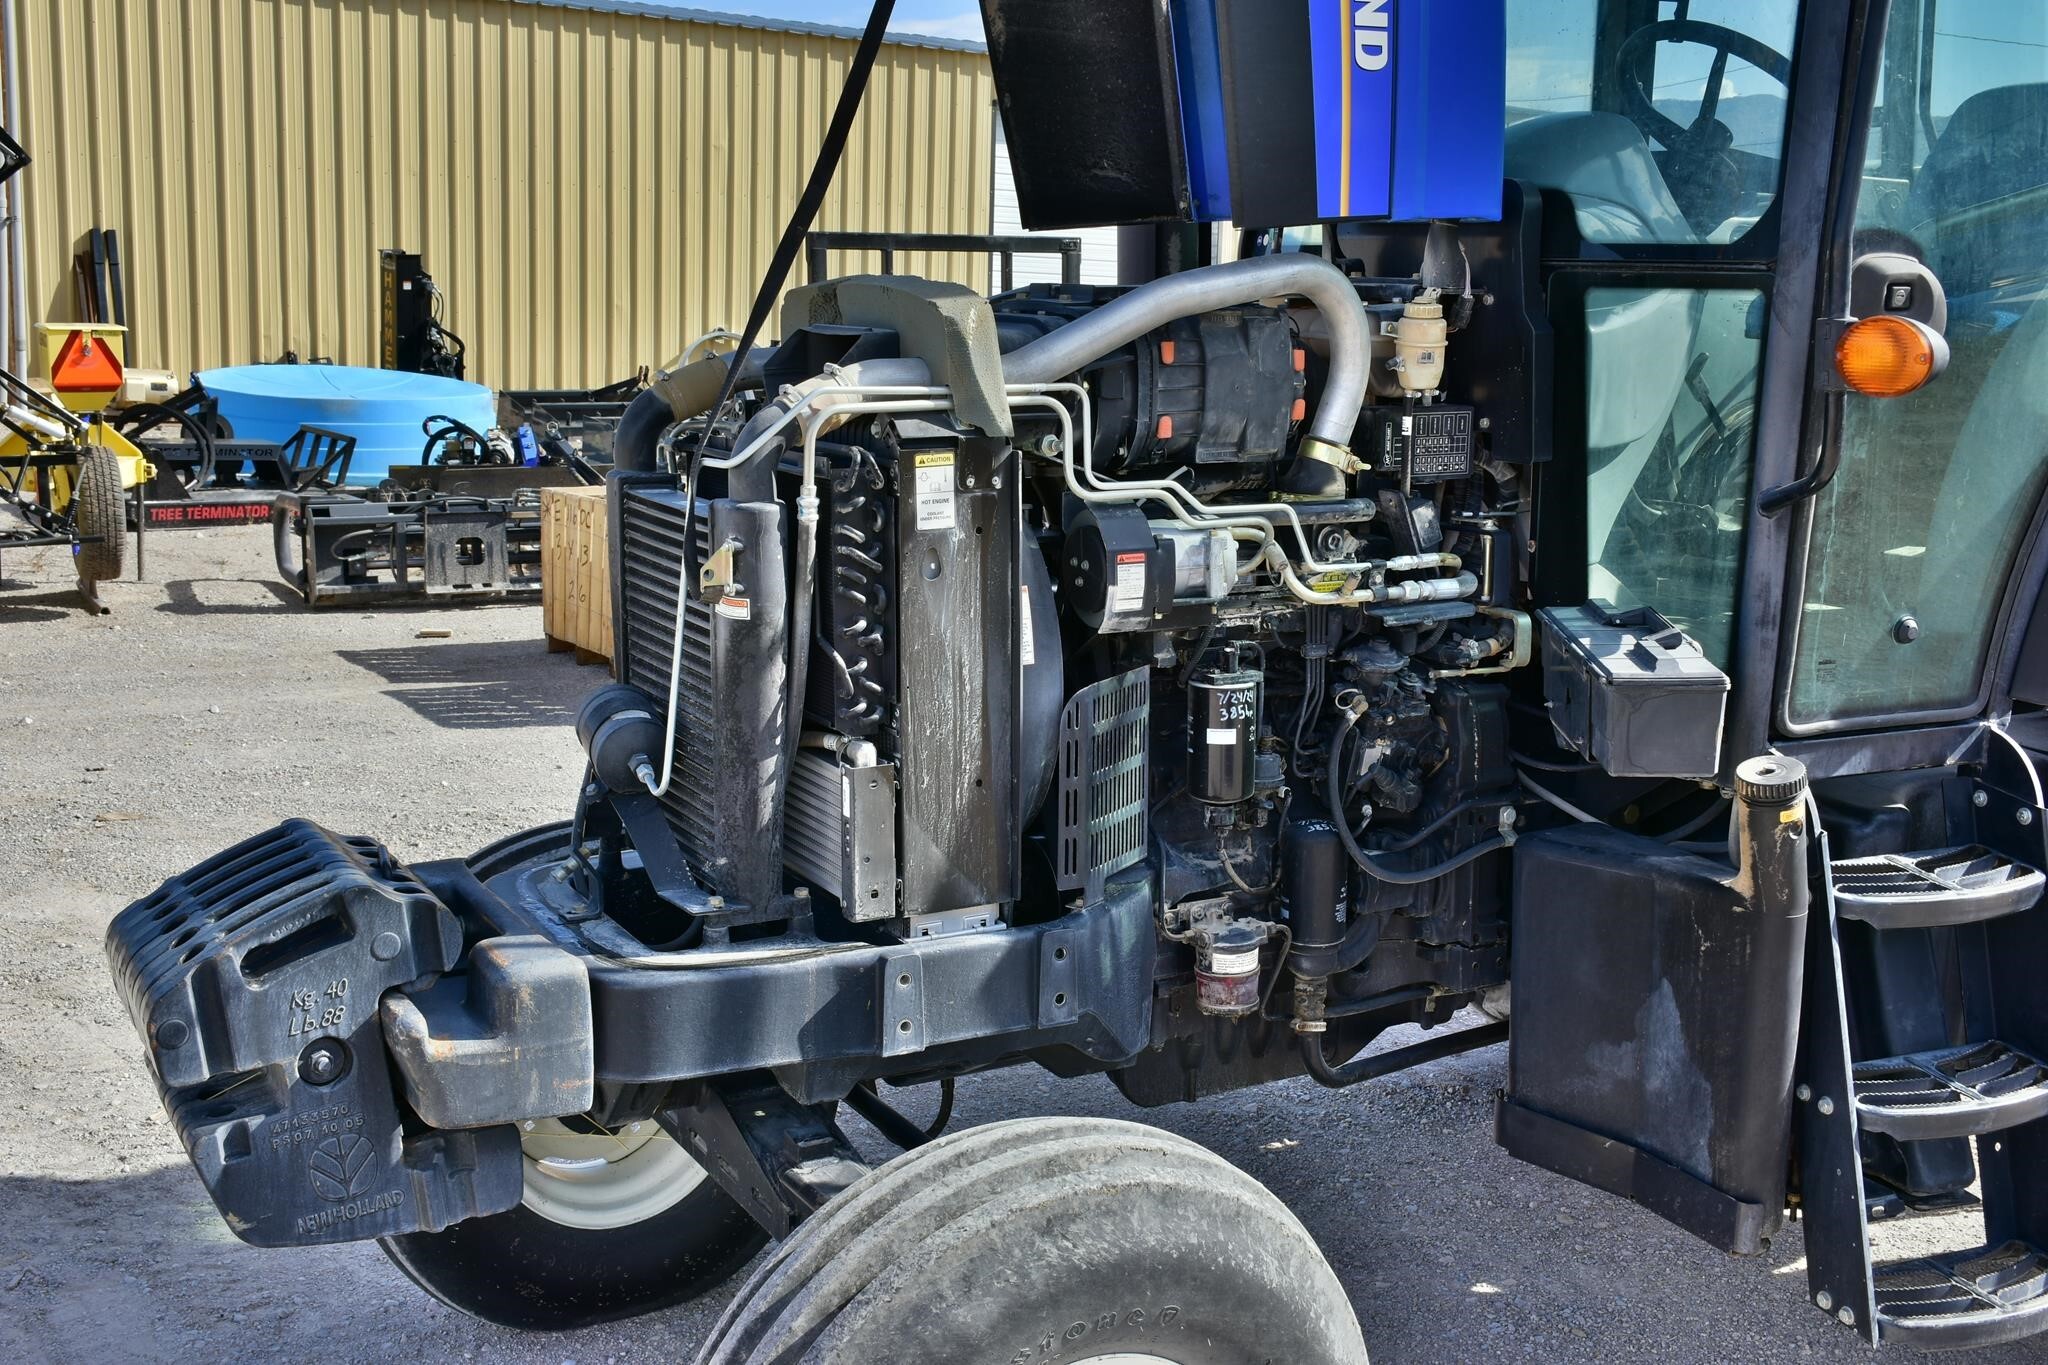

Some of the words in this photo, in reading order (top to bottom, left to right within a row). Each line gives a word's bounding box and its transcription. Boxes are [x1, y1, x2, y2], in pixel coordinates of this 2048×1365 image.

[150, 508, 183, 521] TREE
[187, 505, 269, 520] TERMINATOR
[1216, 689, 1254, 705] 7/24/24
[325, 978, 348, 999] 40
